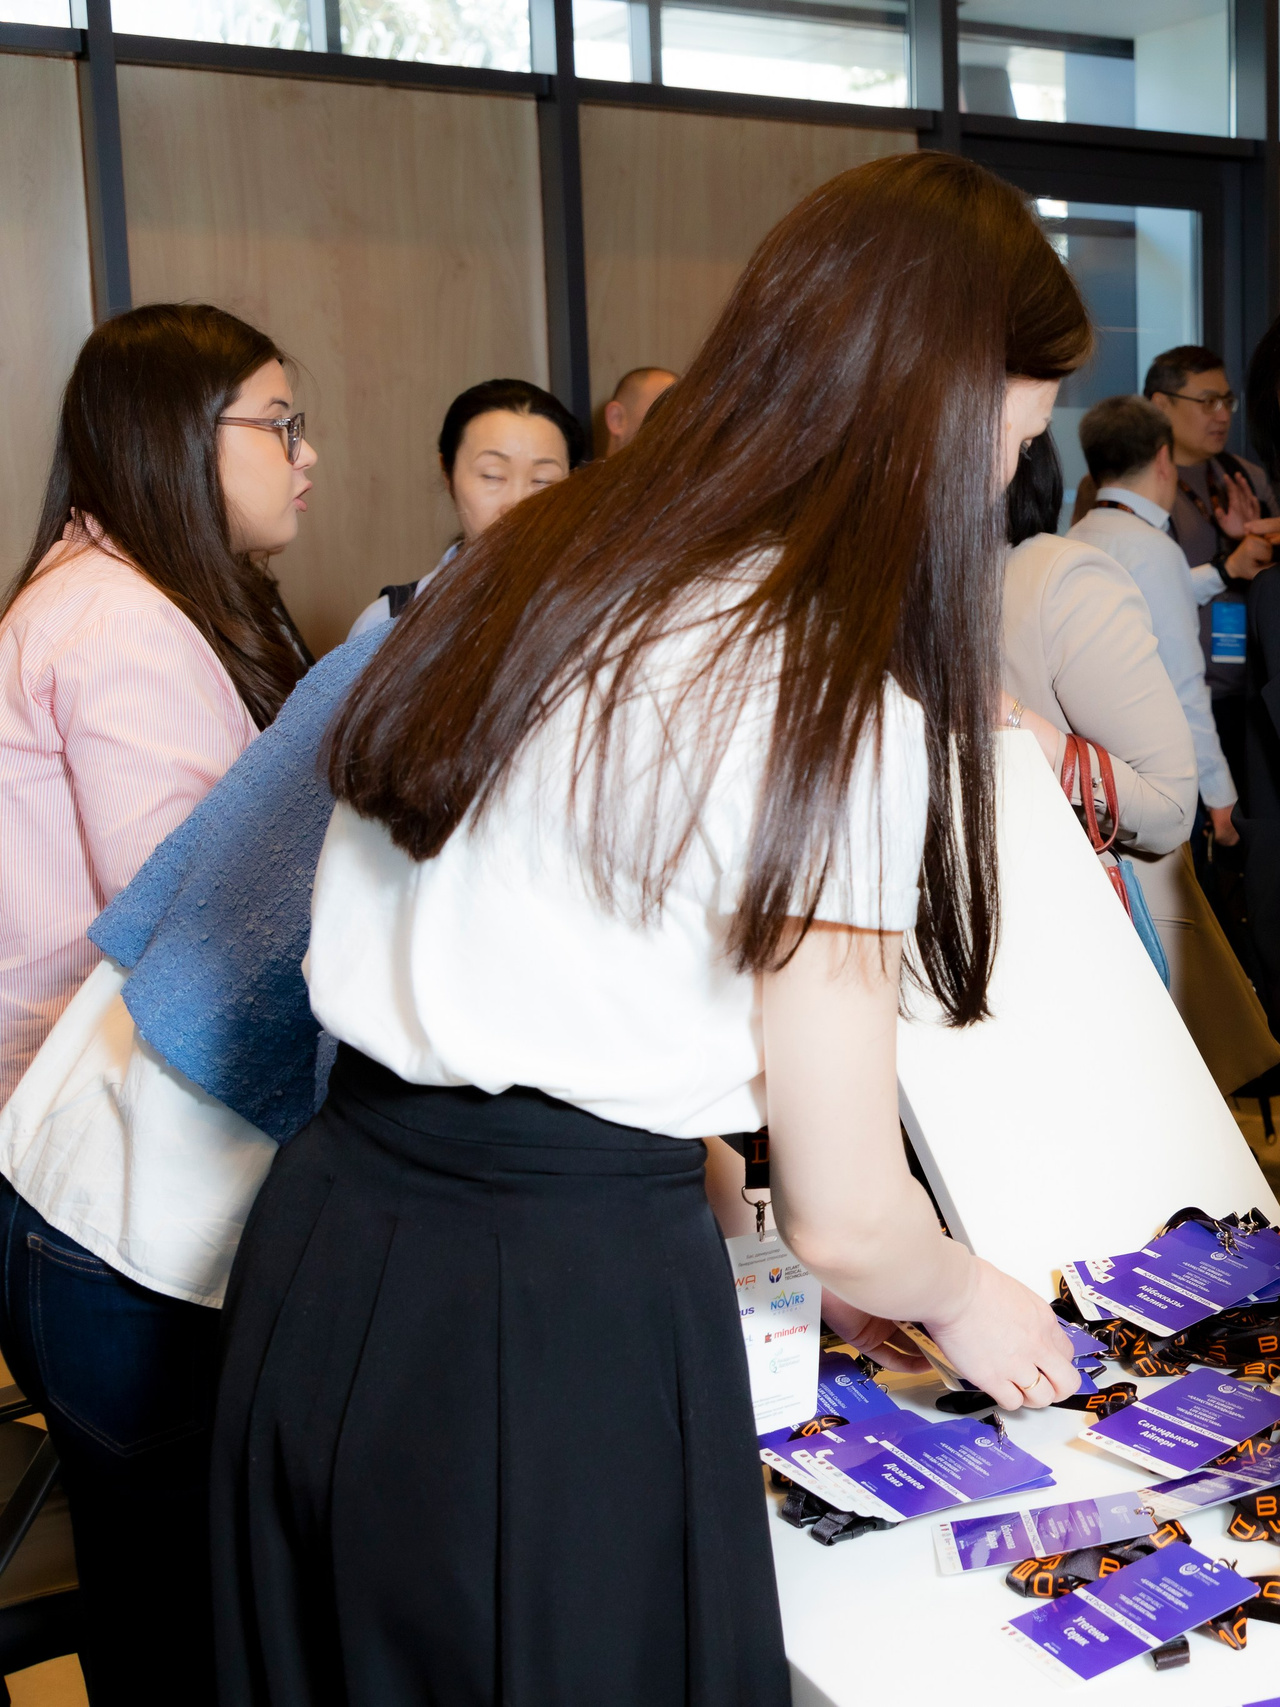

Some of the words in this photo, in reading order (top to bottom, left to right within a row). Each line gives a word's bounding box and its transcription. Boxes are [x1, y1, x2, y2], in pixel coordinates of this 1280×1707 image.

[785, 1272, 809, 1281] TECHNOLOG
[770, 1291, 805, 1311] NOVIRS
[1135, 1292, 1169, 1309] Малика
[1138, 1284, 1184, 1308] Айбеккызы
[774, 1324, 809, 1339] mindray
[1135, 1418, 1200, 1447] Сагындыкова
[1138, 1430, 1177, 1447] Айпери
[1187, 1424, 1226, 1441] УЧАСТНИК
[880, 1472, 905, 1487] Азиз
[881, 1462, 927, 1490] Дозалиев
[926, 1473, 960, 1495] УЧАСТНИК
[1060, 1626, 1091, 1646] Серик
[1072, 1615, 1111, 1643] Утегенов
[1118, 1618, 1151, 1640] УЧАСТНИК
